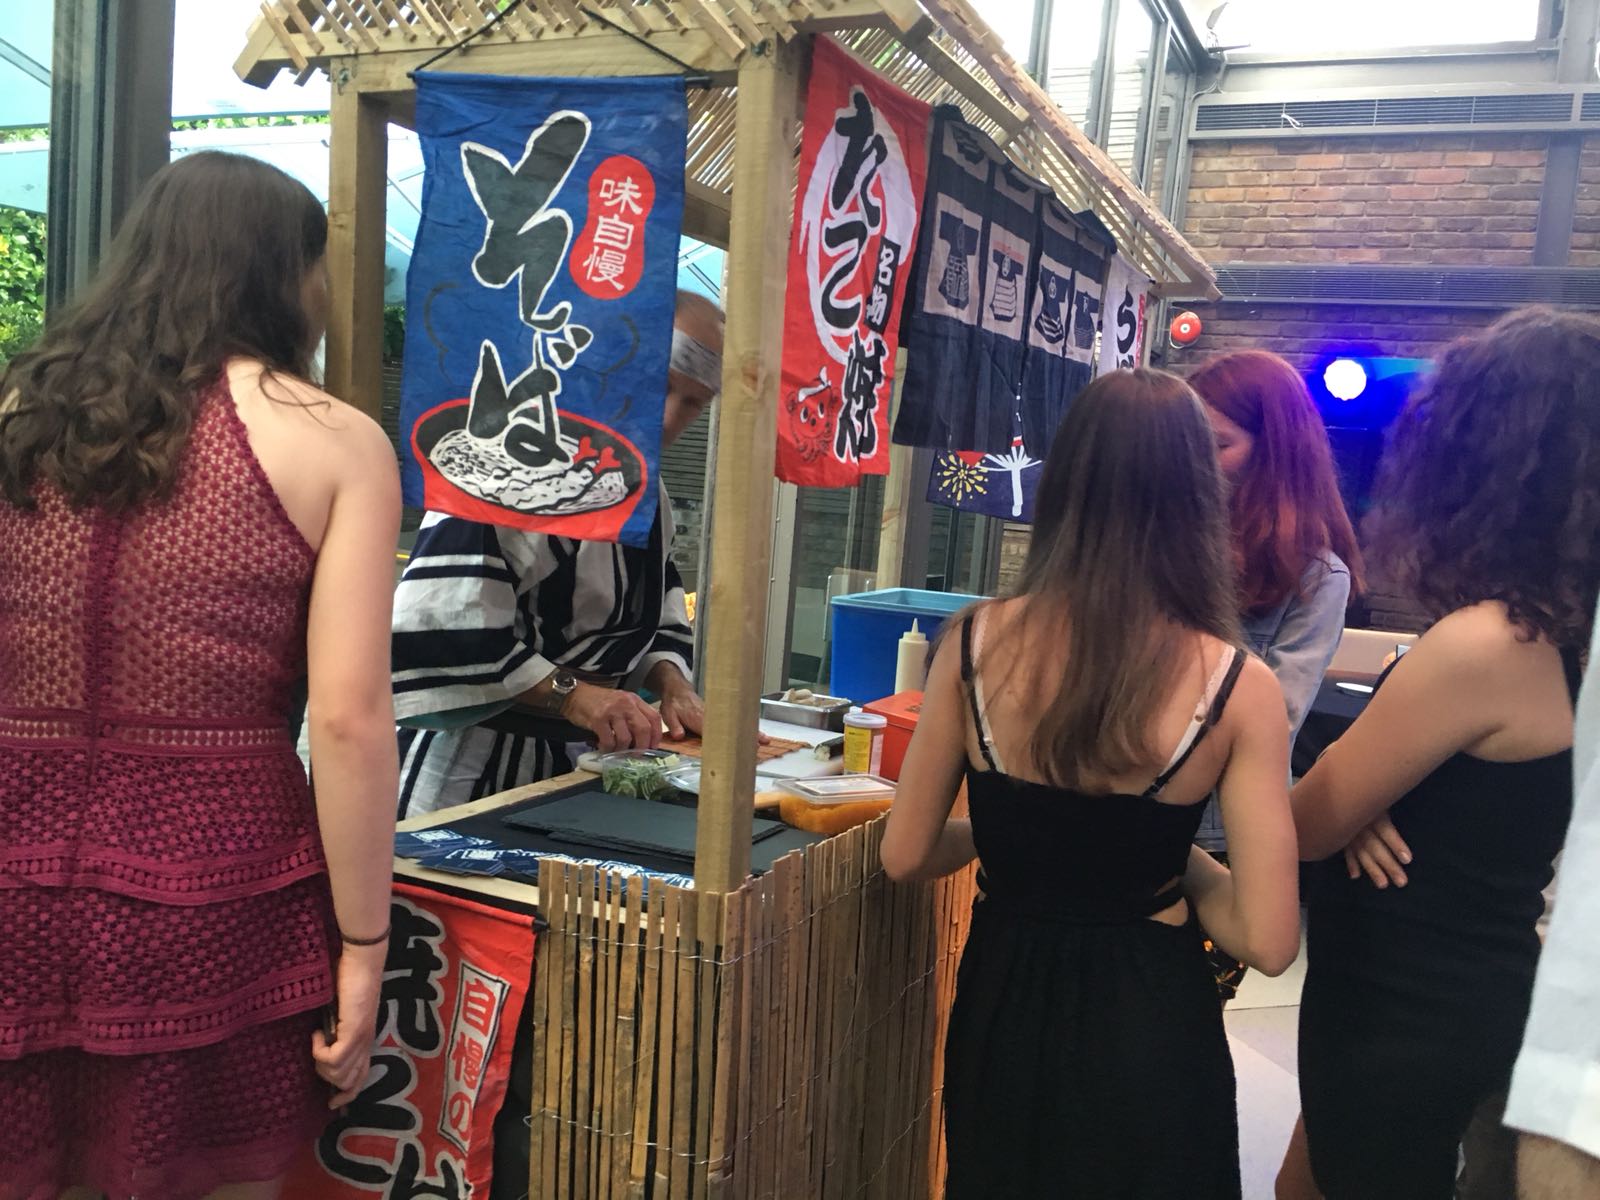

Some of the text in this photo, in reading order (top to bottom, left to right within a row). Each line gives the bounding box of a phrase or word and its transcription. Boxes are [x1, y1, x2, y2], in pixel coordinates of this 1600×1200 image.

[460, 109, 593, 468] そば
[583, 177, 643, 291] 味自慢
[449, 977, 497, 1142] 自慢の
